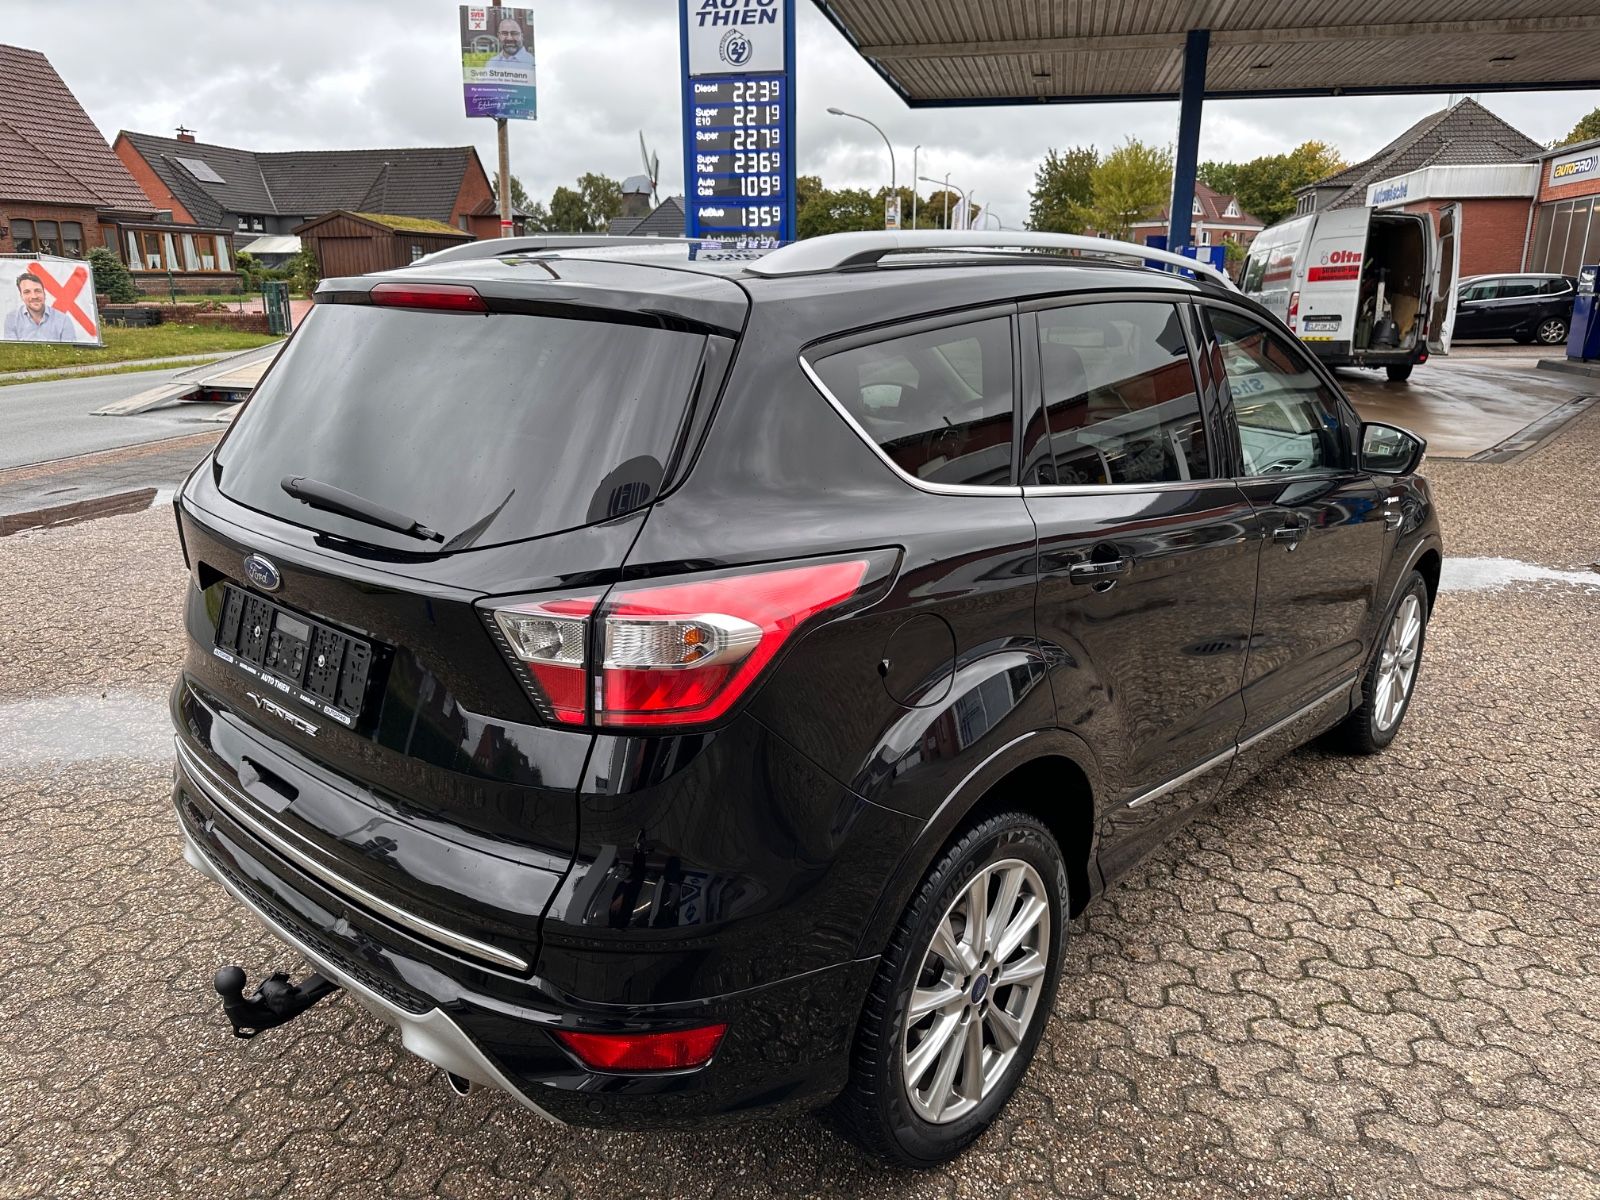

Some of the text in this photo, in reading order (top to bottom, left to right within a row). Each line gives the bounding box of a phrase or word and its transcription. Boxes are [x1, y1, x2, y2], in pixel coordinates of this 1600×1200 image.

[696, 8, 777, 27] THIEN
[731, 41, 746, 53] 24
[470, 69, 528, 79] Sven Stratmann
[694, 81, 780, 103] Diesel 2239
[695, 105, 780, 127] Super 2219
[695, 117, 711, 127] E10
[696, 129, 780, 151] Super 2279
[696, 152, 780, 174] Super 2369
[697, 163, 714, 173] Plus
[697, 176, 781, 196] Auto 1099
[698, 187, 714, 196] Gas
[698, 206, 781, 227] AdBlue 1359
[249, 562, 269, 584] Ford
[260, 672, 290, 694] AUTO THIEN
